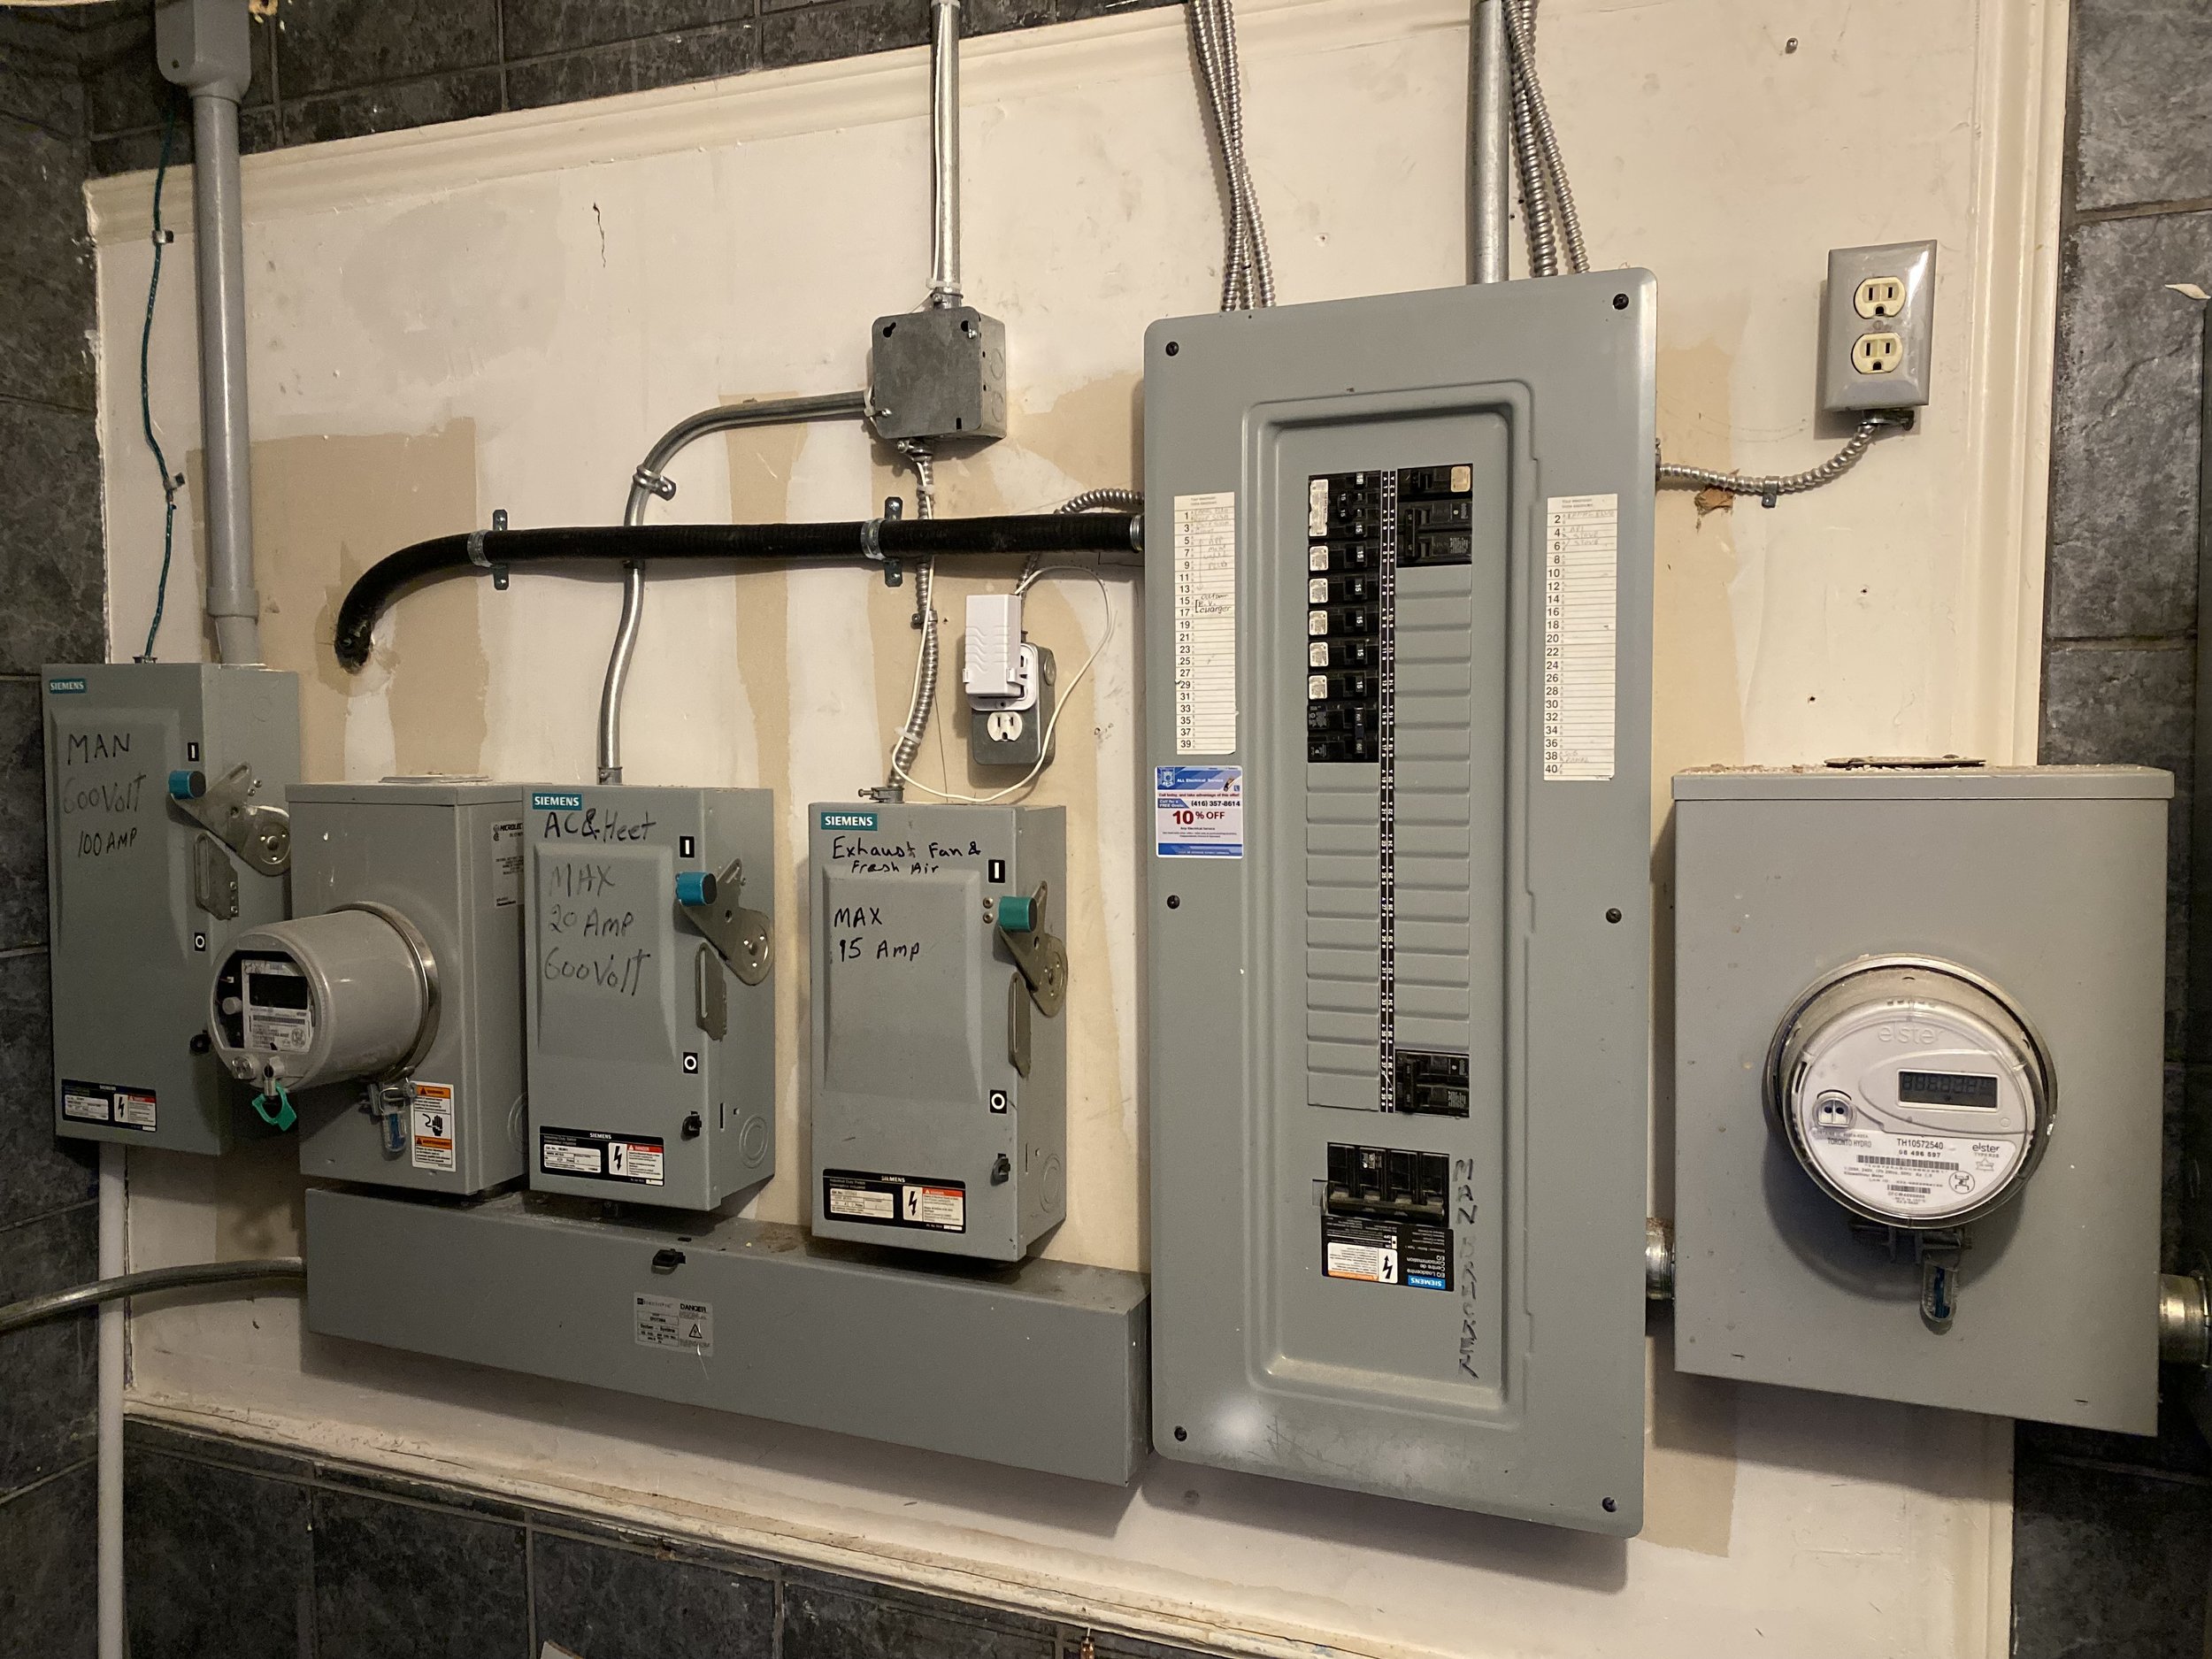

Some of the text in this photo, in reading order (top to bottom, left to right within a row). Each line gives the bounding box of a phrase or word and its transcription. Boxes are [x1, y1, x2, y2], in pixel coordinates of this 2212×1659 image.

[1555, 541, 1560, 550] 6
[1357, 550, 1363, 559] 15
[1548, 595, 1559, 603] 14
[1548, 620, 1559, 629] 18
[1547, 673, 1558, 682] 26
[50, 681, 84, 690] SIEMENS
[1547, 687, 1558, 695] 28
[1547, 700, 1558, 709] 30
[1546, 726, 1557, 734] 34
[1546, 739, 1557, 748] 36
[68, 733, 130, 765] MAN
[1546, 764, 1557, 773] 40
[534, 796, 580, 807] SIEMENS
[826, 817, 873, 826] SIEMENS
[1172, 810, 1194, 825] 10
[78, 827, 137, 858] 100 AMP
[833, 835, 981, 859] Exhaust Fan &
[851, 860, 939, 875] Fresh Air
[549, 863, 616, 897] MAX
[549, 903, 576, 933] 20
[834, 907, 882, 928] MAX
[840, 937, 864, 963] 15
[1878, 1021, 1945, 1045] elster
[1828, 1138, 1872, 1148] TORONTO HYDRO
[1897, 1139, 1944, 1150] TH10572540
[1972, 1142, 2001, 1153] elster
[1410, 1278, 1442, 1287] SIEMENS
[680, 1303, 707, 1312] DANGER
